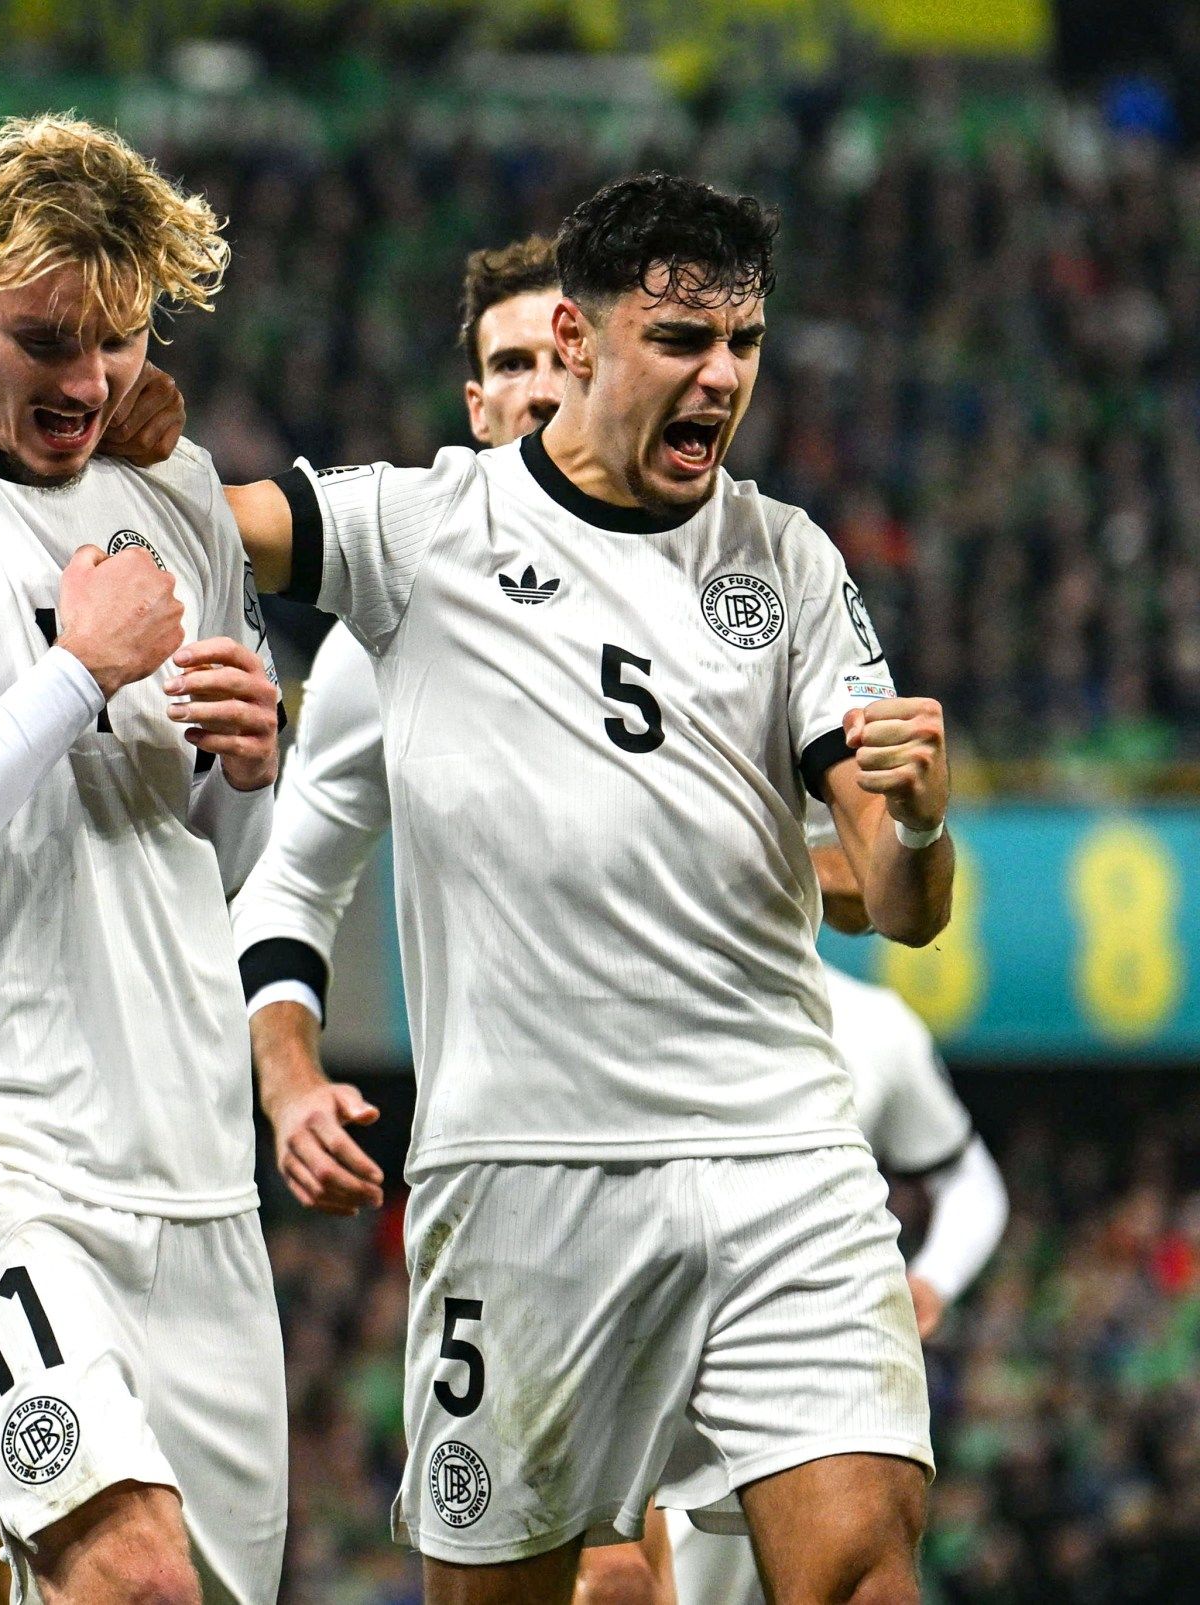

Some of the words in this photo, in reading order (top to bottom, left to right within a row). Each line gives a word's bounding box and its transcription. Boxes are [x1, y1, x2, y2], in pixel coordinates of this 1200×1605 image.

[706, 581, 730, 637] DEUTSCHER
[728, 577, 780, 639] FUSSBALL-BUND
[738, 637, 755, 646] 125
[601, 644, 665, 753] 5
[434, 1297, 485, 1417] 5
[5, 1421, 37, 1479] DEUTSCHER
[16, 1400, 74, 1455] FUSSBALL-BUND
[45, 1461, 61, 1476] 125
[448, 1445, 486, 1518] FUSSBALL-BUND
[449, 1513, 462, 1524] 125
